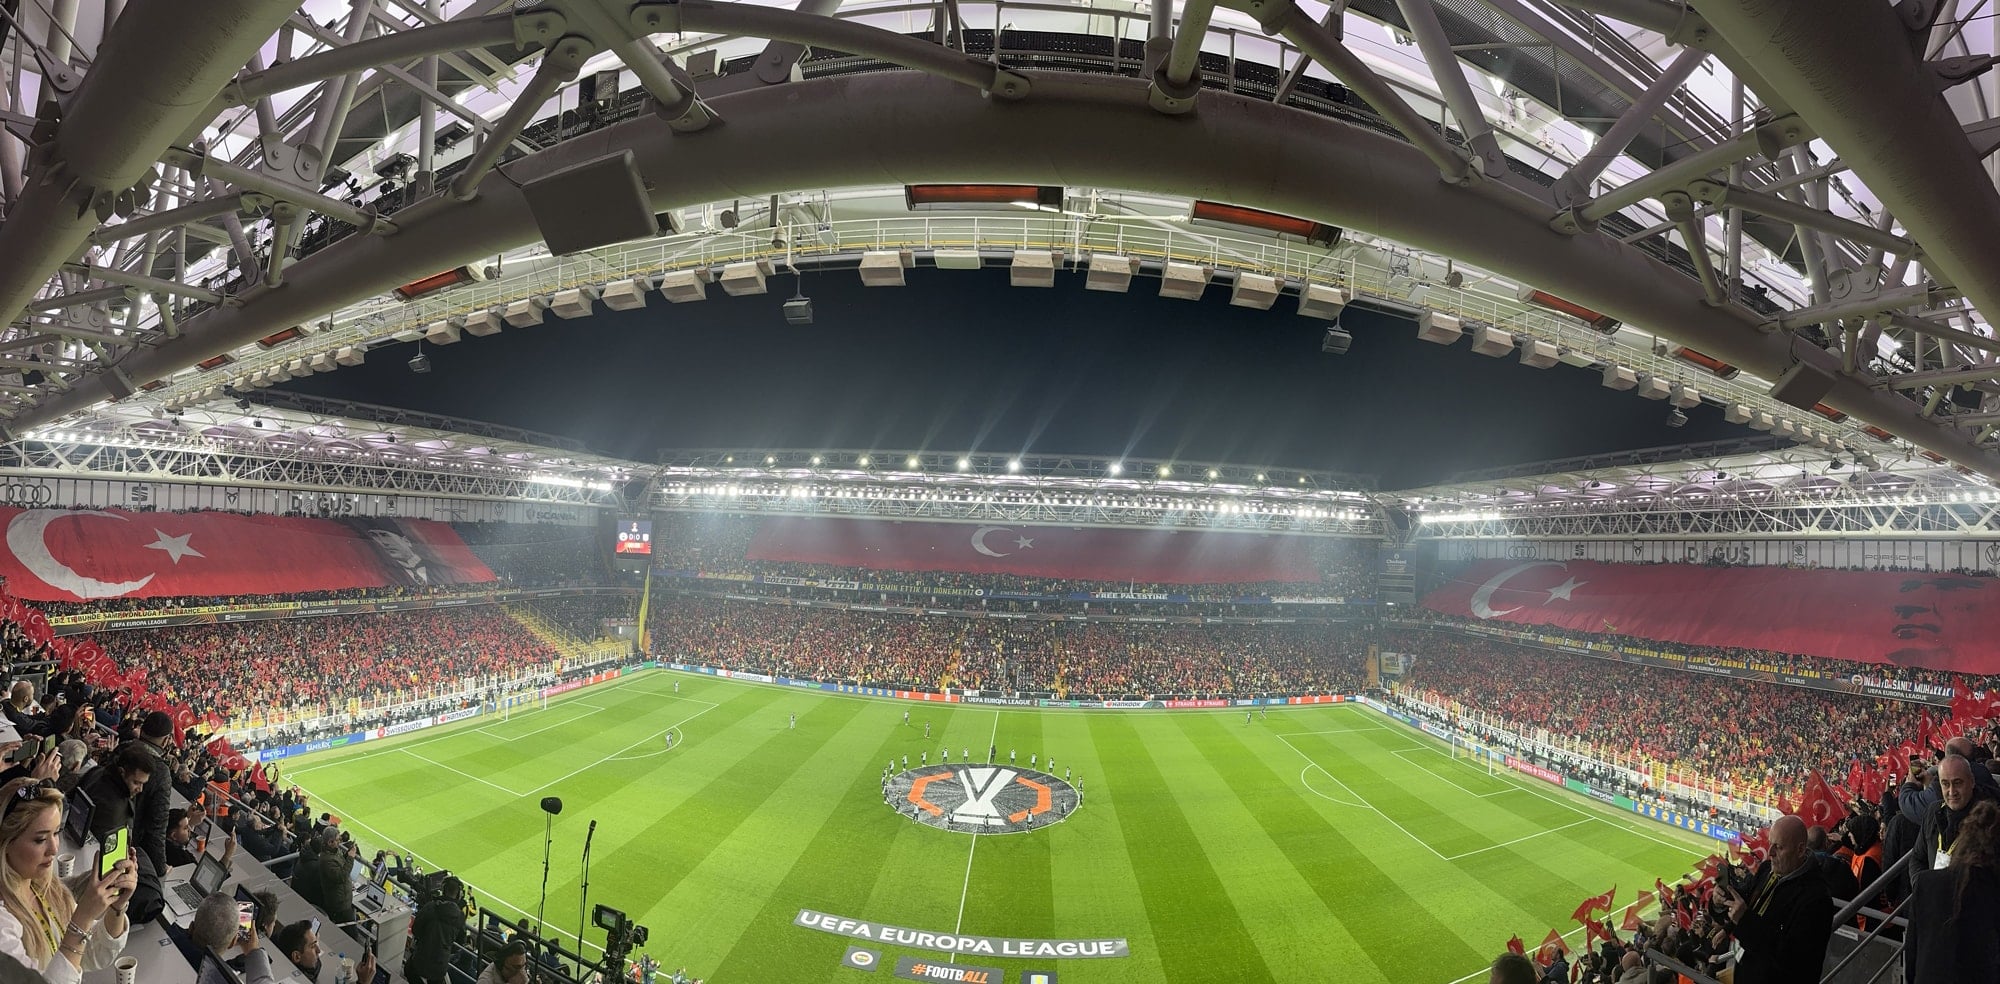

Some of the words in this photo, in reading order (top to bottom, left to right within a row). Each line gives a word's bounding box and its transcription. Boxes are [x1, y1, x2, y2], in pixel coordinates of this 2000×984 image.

[1864, 554, 1926, 562] PORSCHE
[1882, 690, 1904, 698] EUROPA
[1905, 693, 1928, 701] LEAGUE
[385, 721, 422, 736] Swissquote
[262, 748, 286, 759] RECYCLE
[1512, 758, 1534, 773] STRAUSS
[1538, 767, 1560, 782] STRAUSS
[1716, 828, 1739, 840] RECYCL
[800, 911, 872, 937] UEFA
[879, 927, 995, 954] EUROPA
[1002, 940, 1115, 956] LEAGUE
[911, 963, 989, 984] #FOOTBALL
